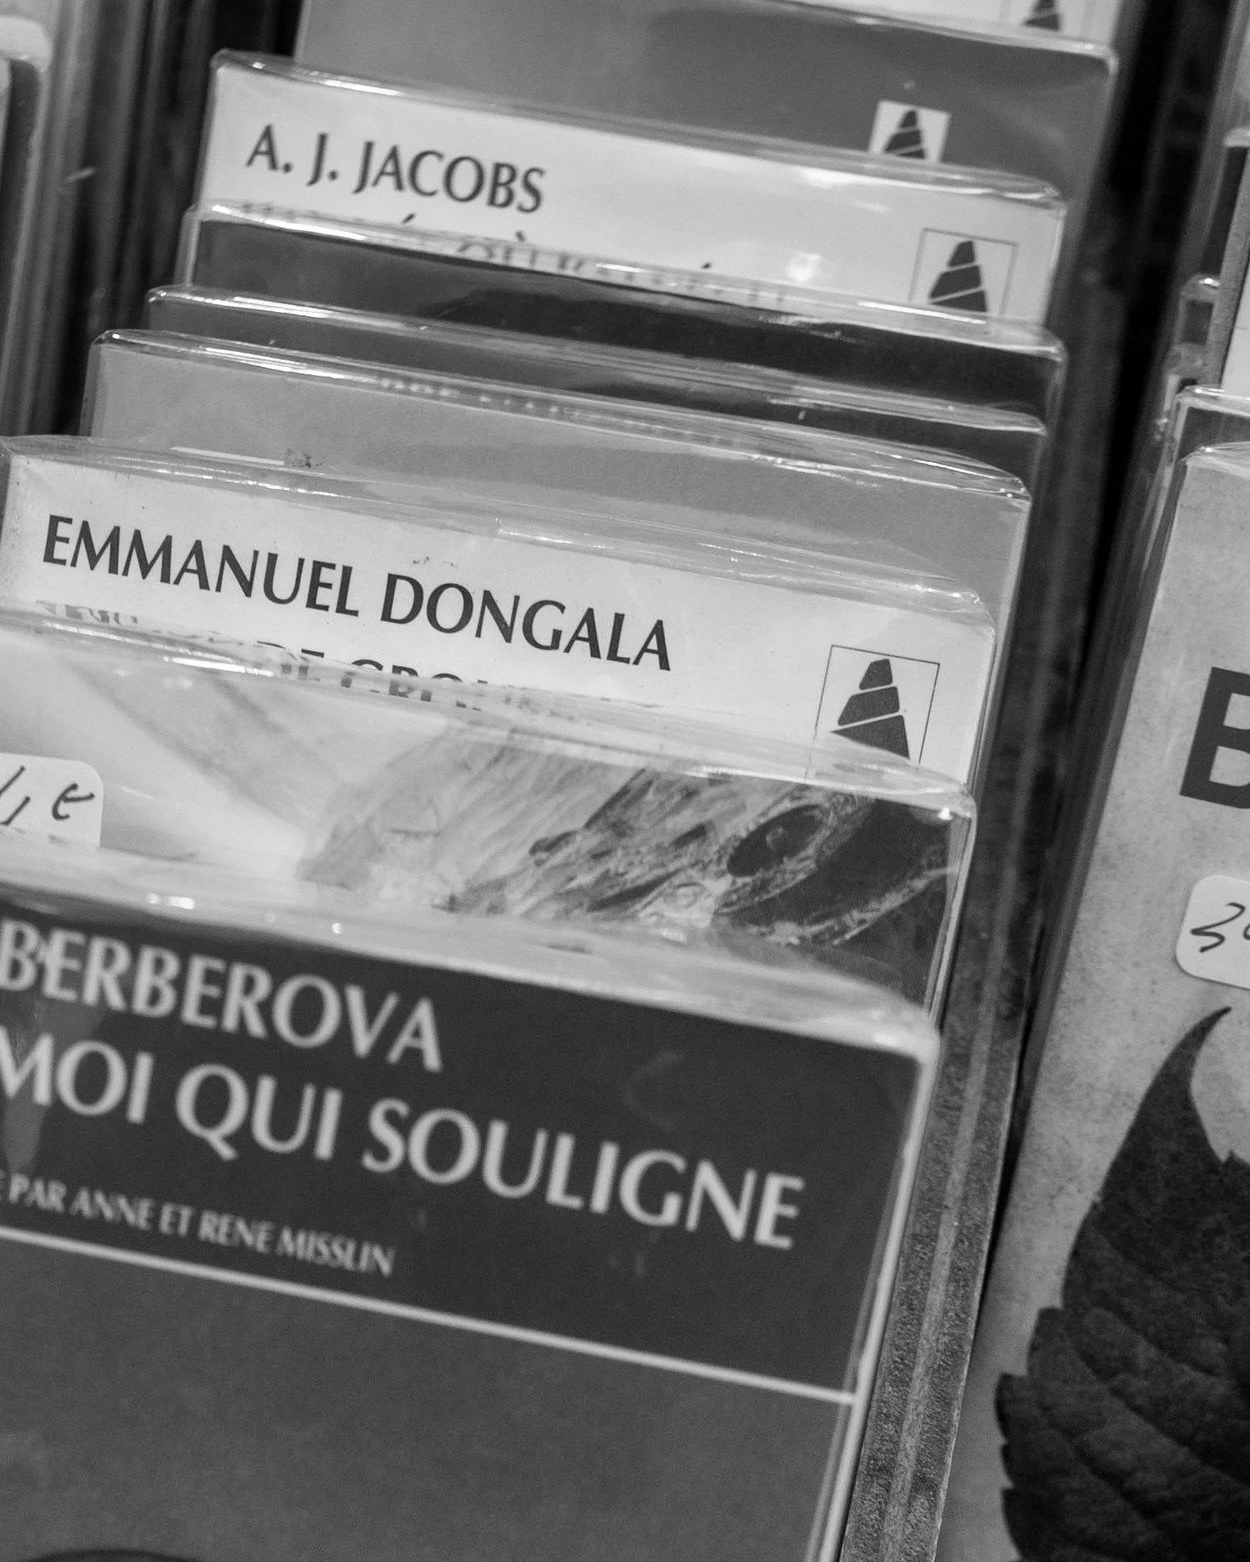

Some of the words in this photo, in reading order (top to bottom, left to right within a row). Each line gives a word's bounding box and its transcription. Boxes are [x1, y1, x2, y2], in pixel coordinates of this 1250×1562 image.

[246, 124, 292, 174] A.
[307, 133, 338, 187] J.
[352, 141, 546, 214] JACOBS
[42, 514, 359, 617] EMMANUEL
[380, 572, 671, 672] DONGALA
[175, 1063, 342, 1161] QUI
[362, 1098, 803, 1250] SOULIGNE
[8, 1172, 67, 1213] PAR
[70, 1187, 153, 1231] ANNE
[159, 1202, 193, 1237] ET
[277, 1225, 396, 1278] MISSLIN
